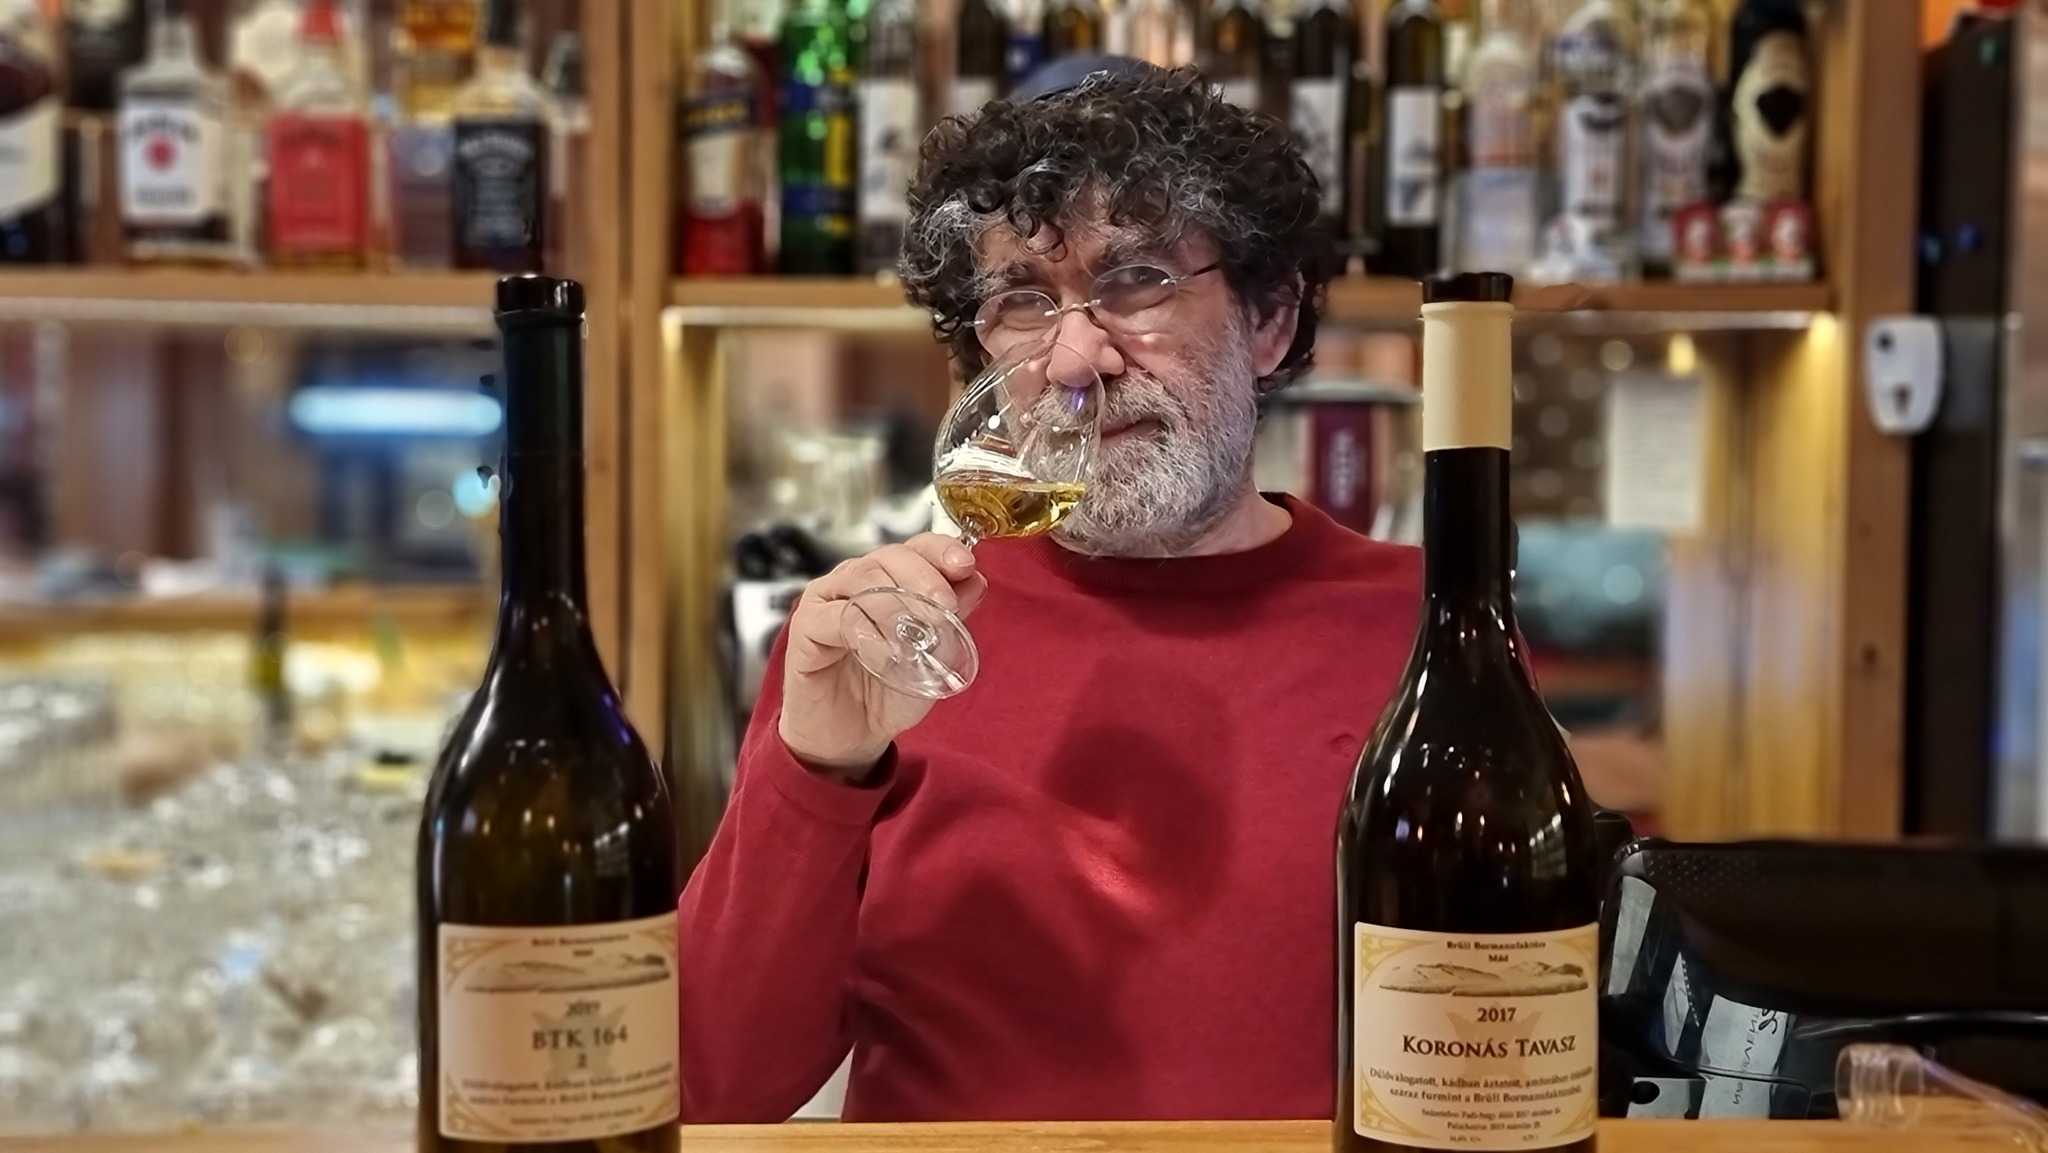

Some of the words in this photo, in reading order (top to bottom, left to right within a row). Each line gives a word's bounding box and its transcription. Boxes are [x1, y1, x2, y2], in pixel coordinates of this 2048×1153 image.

[1477, 1007, 1517, 1023] 2017
[532, 1030, 583, 1051] BTK
[593, 1025, 628, 1046] 164
[1402, 1034, 1508, 1058] KORONÁS
[1515, 1035, 1577, 1057] TAVASZ
[1421, 1091, 1462, 1102] furmint
